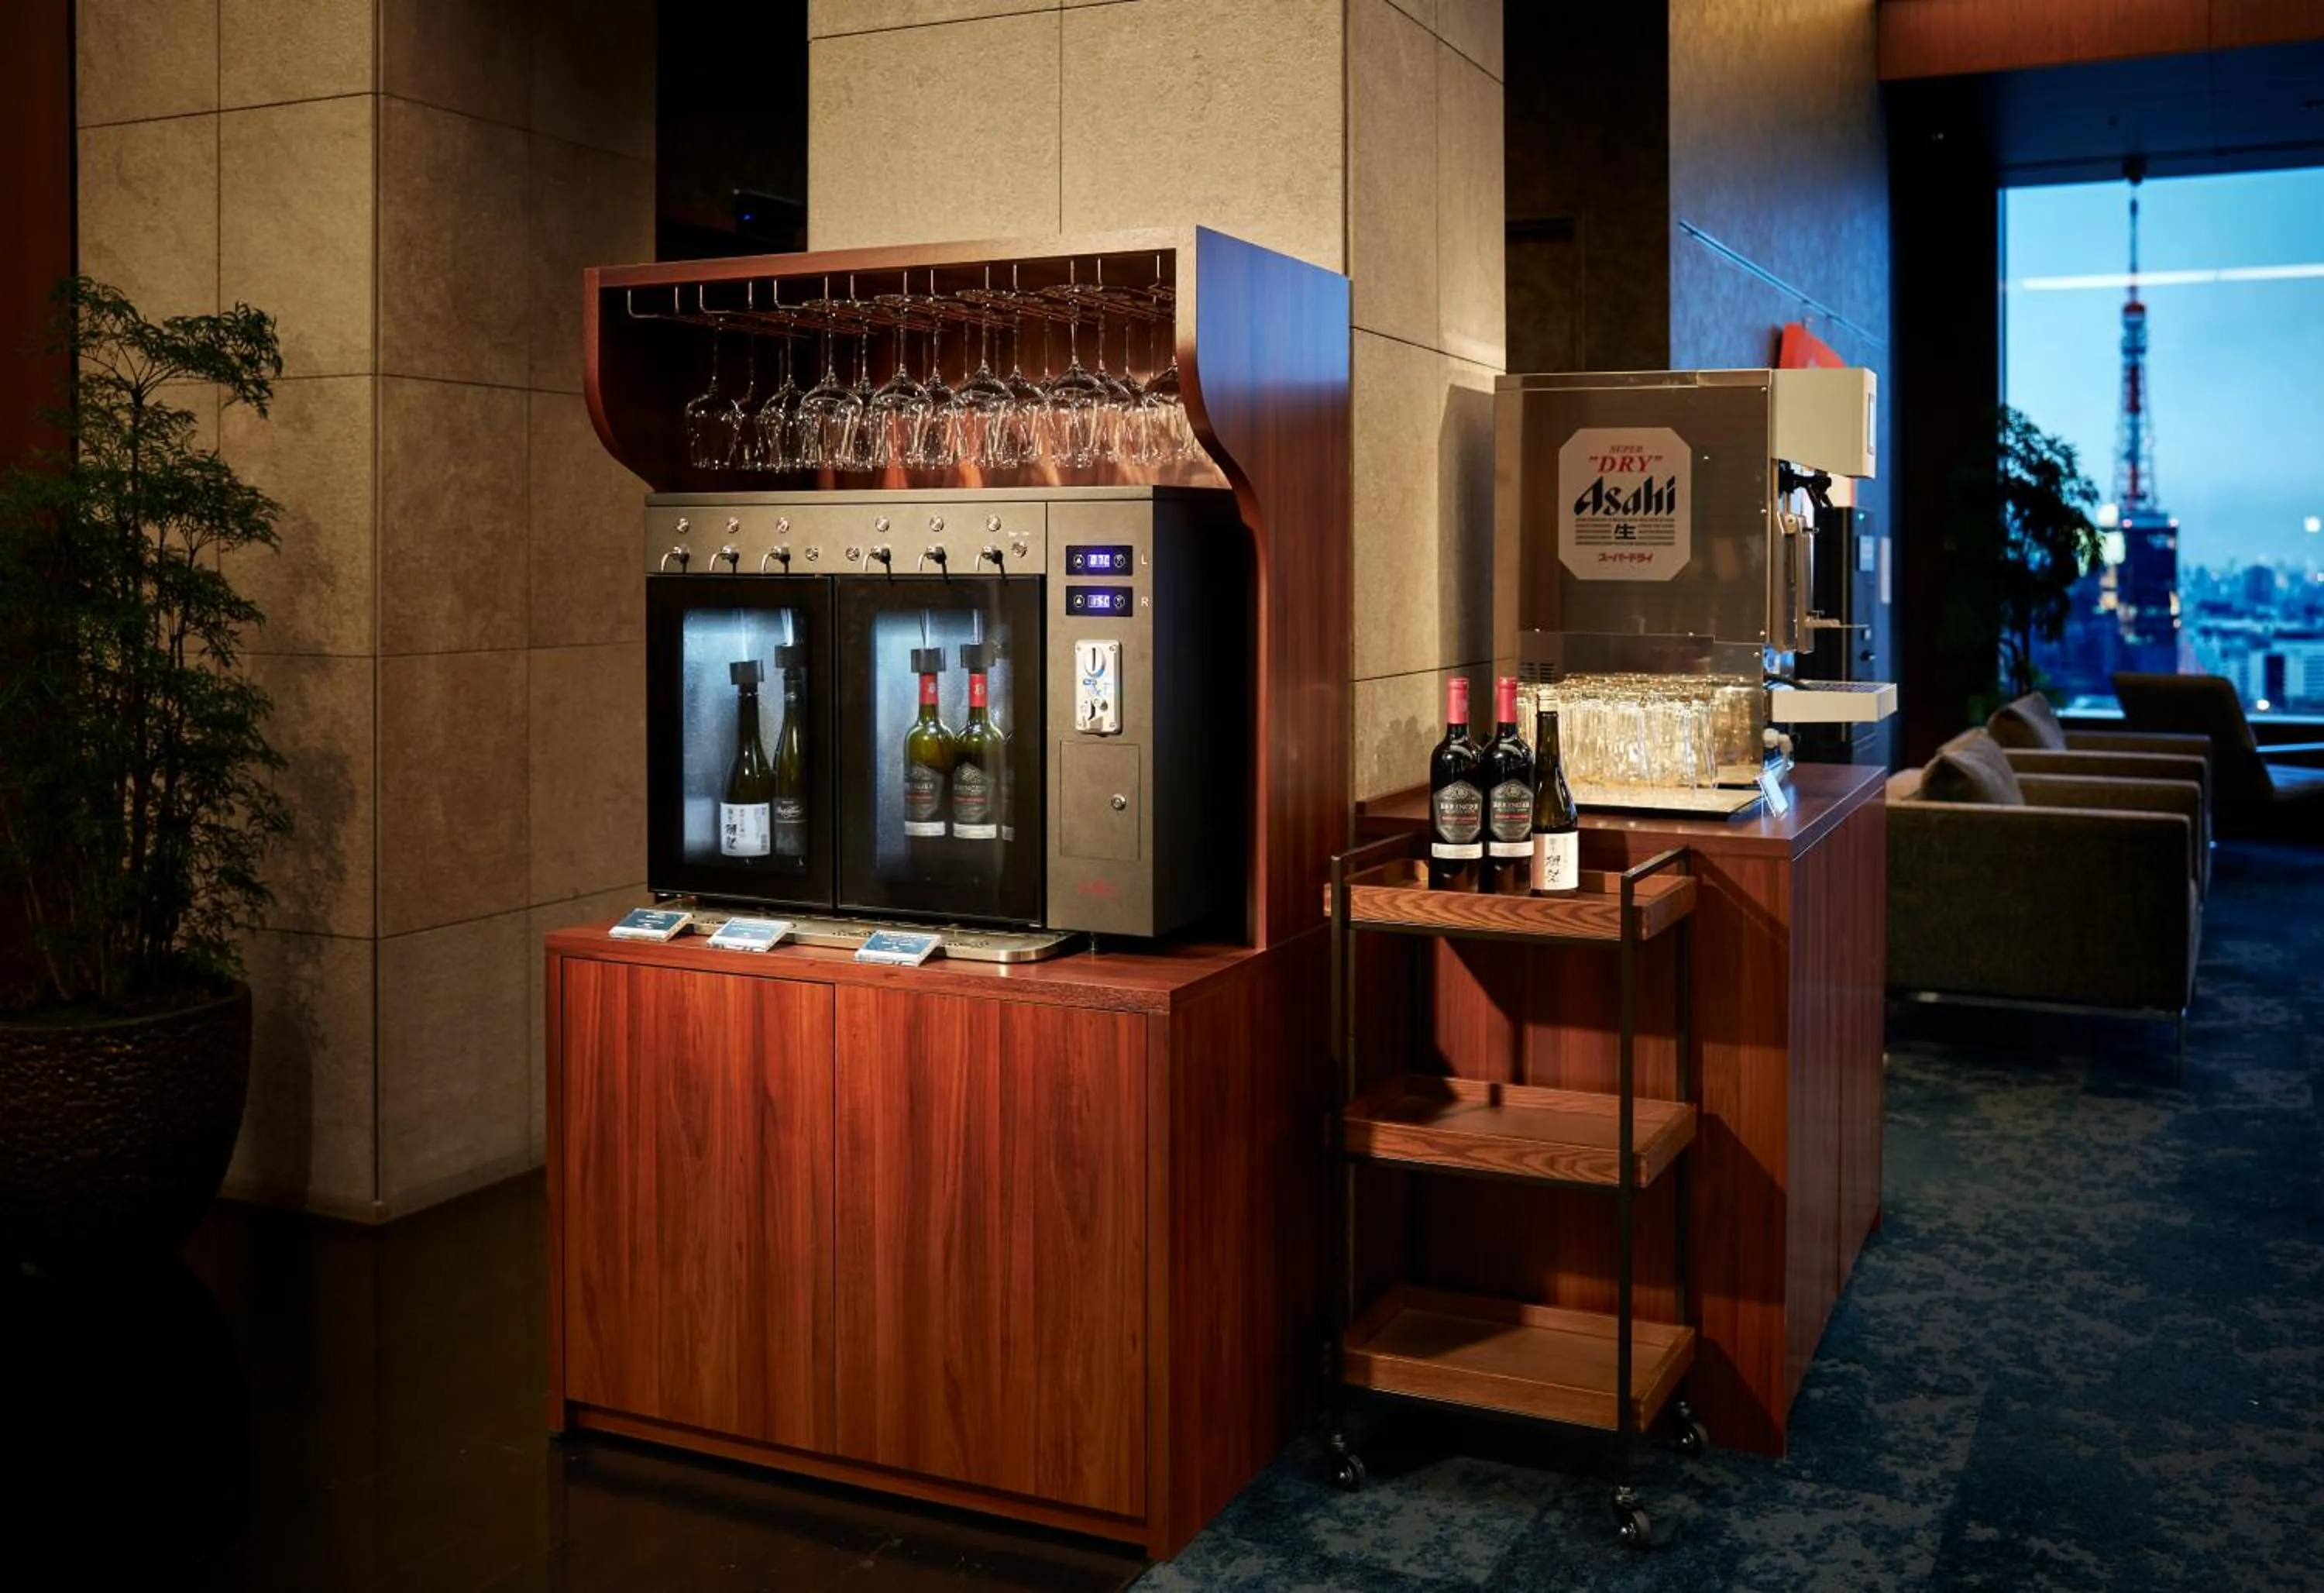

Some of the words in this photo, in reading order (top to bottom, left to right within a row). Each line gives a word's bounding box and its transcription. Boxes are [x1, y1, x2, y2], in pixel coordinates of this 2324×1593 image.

[1573, 475, 1676, 516] Asahi
[1614, 523, 1637, 540] 生
[1140, 554, 1148, 566] L
[1598, 552, 1654, 563] スーパードライ
[1140, 597, 1150, 607] R
